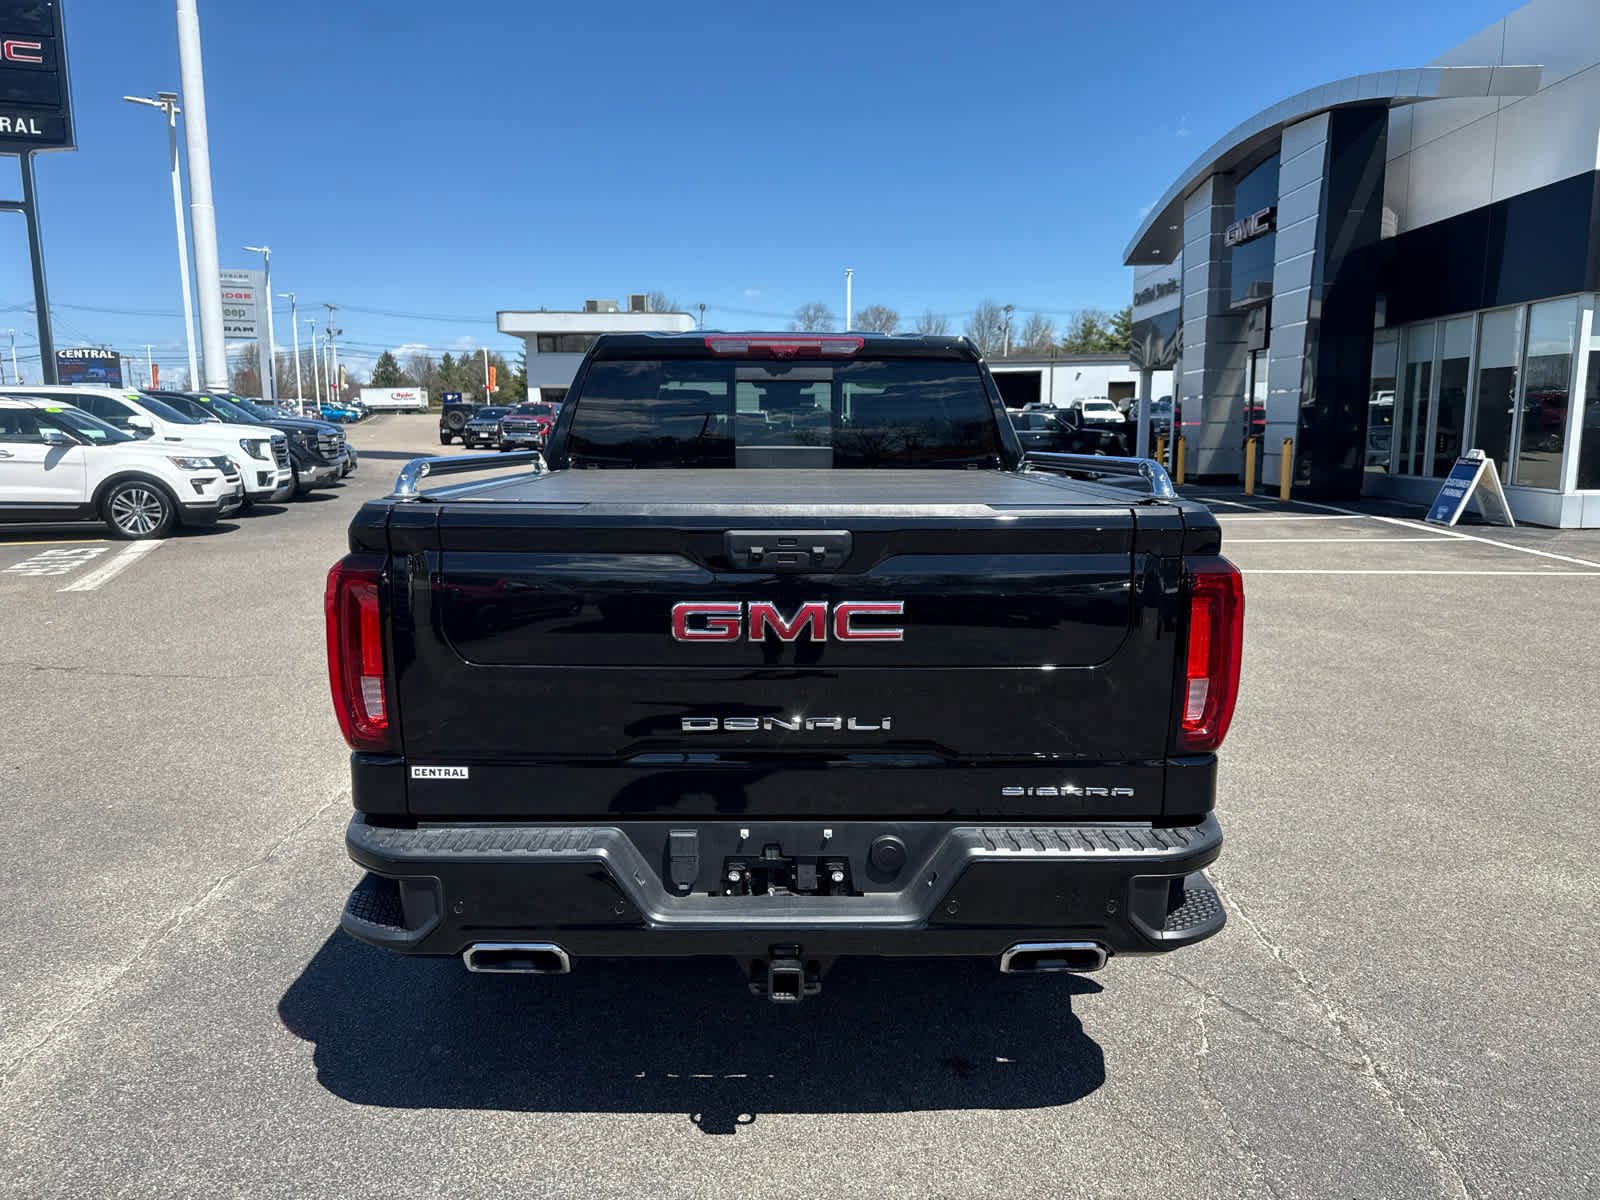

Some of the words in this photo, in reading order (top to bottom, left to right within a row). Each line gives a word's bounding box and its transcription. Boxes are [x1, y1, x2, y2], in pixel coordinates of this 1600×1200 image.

[1224, 207, 1270, 247] GMC
[223, 308, 246, 319] eep
[58, 349, 115, 359] CENTRAL
[671, 601, 905, 642] GMC
[681, 716, 892, 731] DENALI
[413, 768, 467, 777] CENTRAL
[1001, 786, 1135, 797] SIERRA
